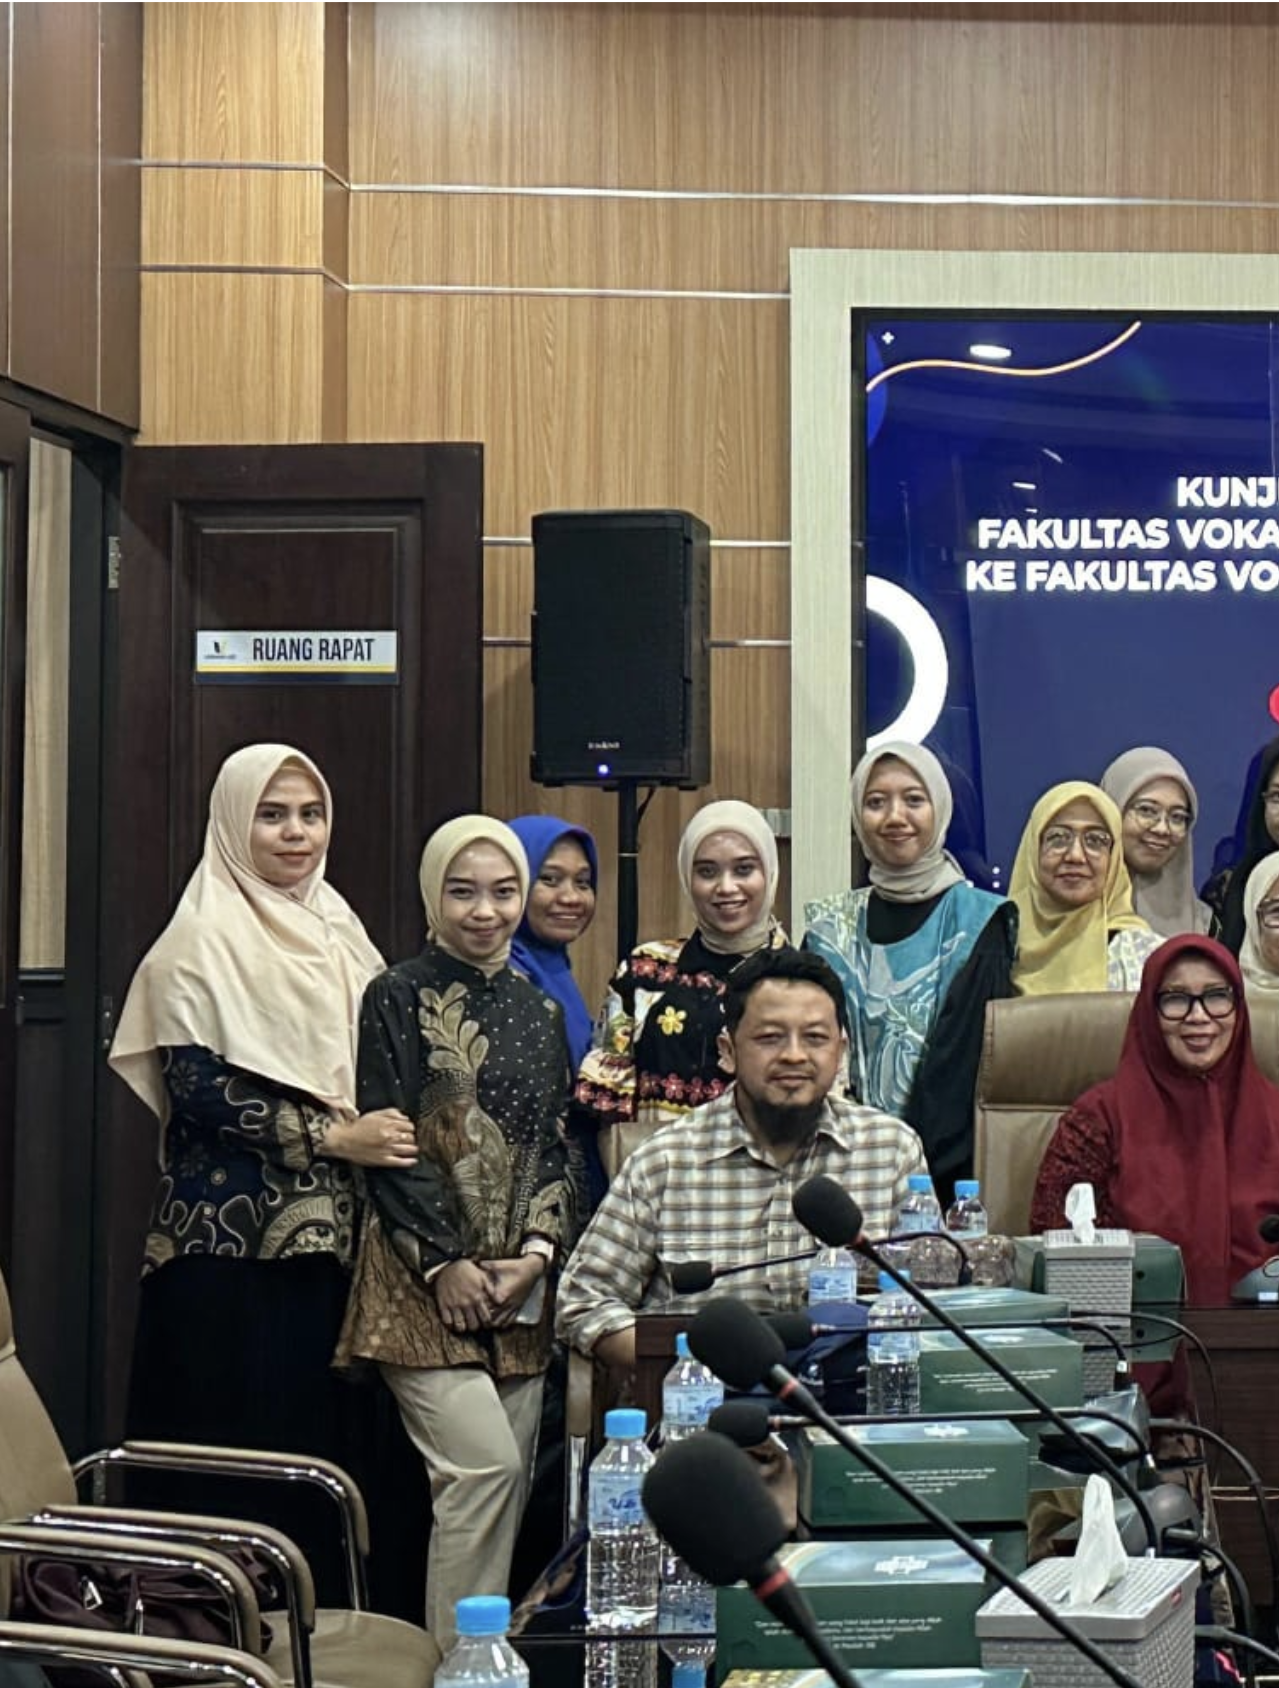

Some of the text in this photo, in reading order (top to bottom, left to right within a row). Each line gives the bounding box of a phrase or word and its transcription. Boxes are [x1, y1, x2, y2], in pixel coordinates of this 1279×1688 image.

[978, 517, 1170, 550] FAKULTAS
[966, 560, 1017, 592] KE
[1025, 560, 1218, 592] FAKULTAS
[253, 638, 375, 661] RUANG RAPAT
